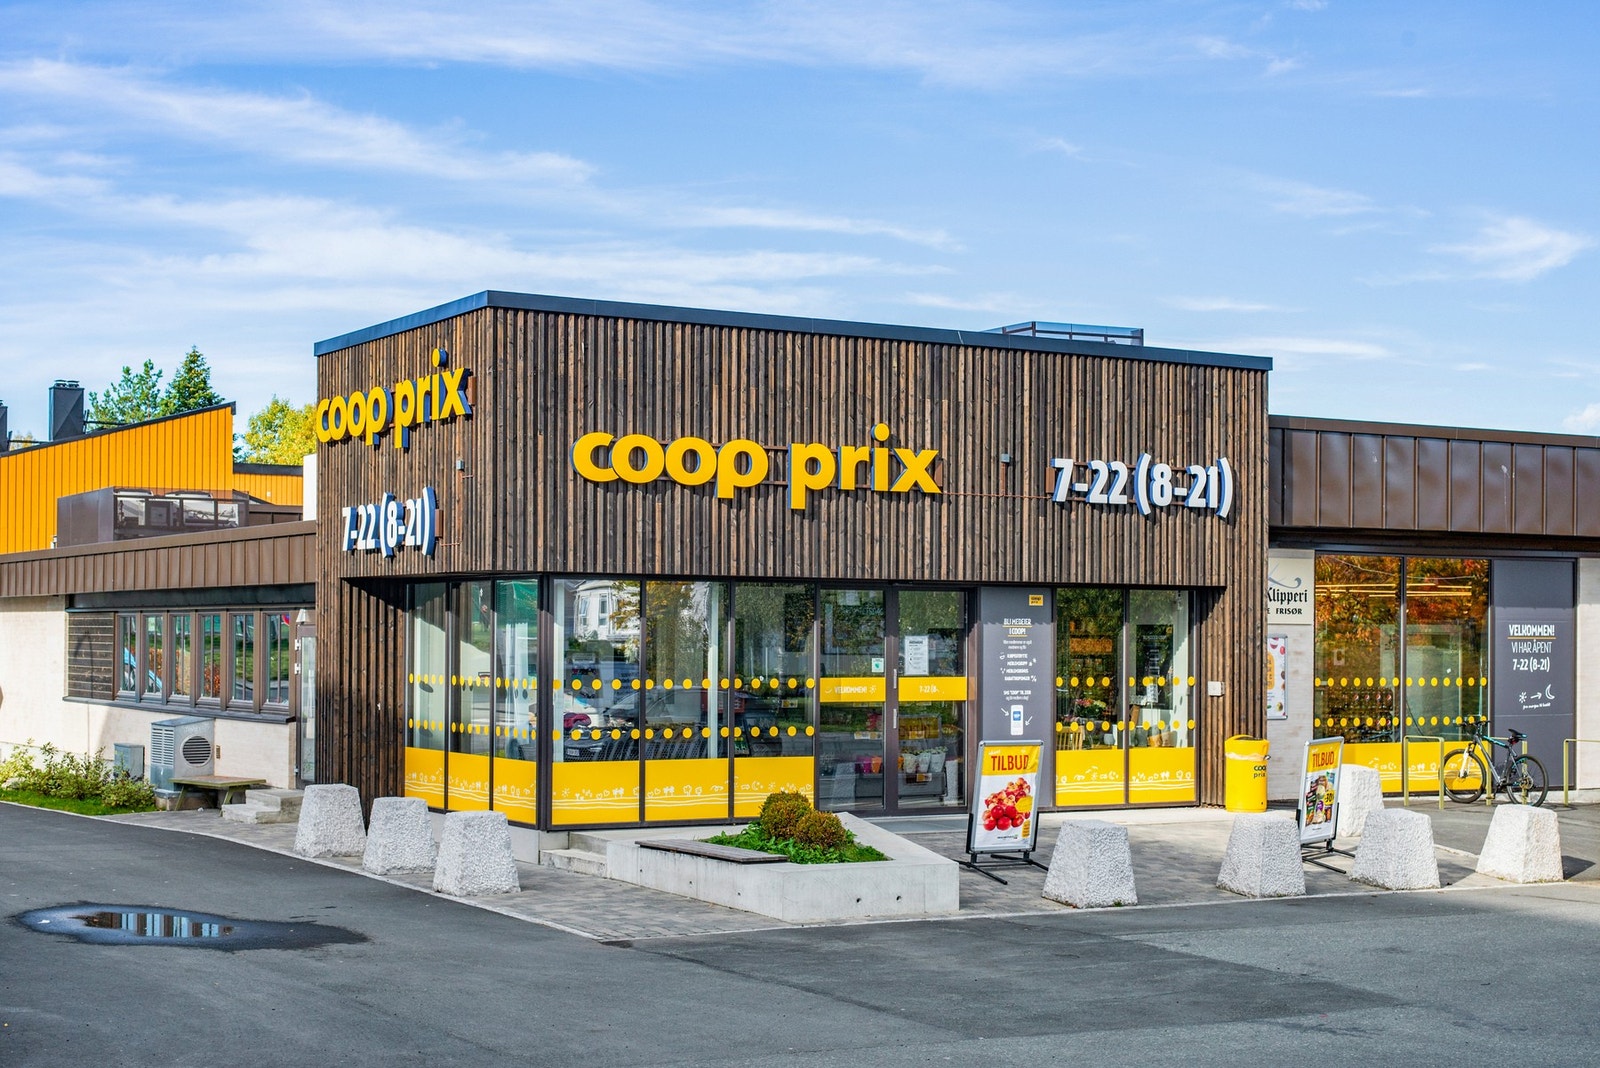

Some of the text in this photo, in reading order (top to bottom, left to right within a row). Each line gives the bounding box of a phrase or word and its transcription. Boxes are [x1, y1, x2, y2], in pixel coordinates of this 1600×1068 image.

[316, 348, 472, 449] coop prix
[571, 423, 942, 510] coop prix
[1051, 453, 1234, 518] 7-22 (8-21)
[342, 486, 437, 558] 7-22 (8-21)
[1275, 607, 1303, 615] FRISØR
[1508, 624, 1555, 636] VELKOMMEN!
[1511, 639, 1552, 653] VI HAR ÅPENT
[1512, 656, 1551, 672] 7-22 (8-21)
[990, 754, 1029, 771] TILBUD
[1312, 751, 1336, 768] TILBUD
